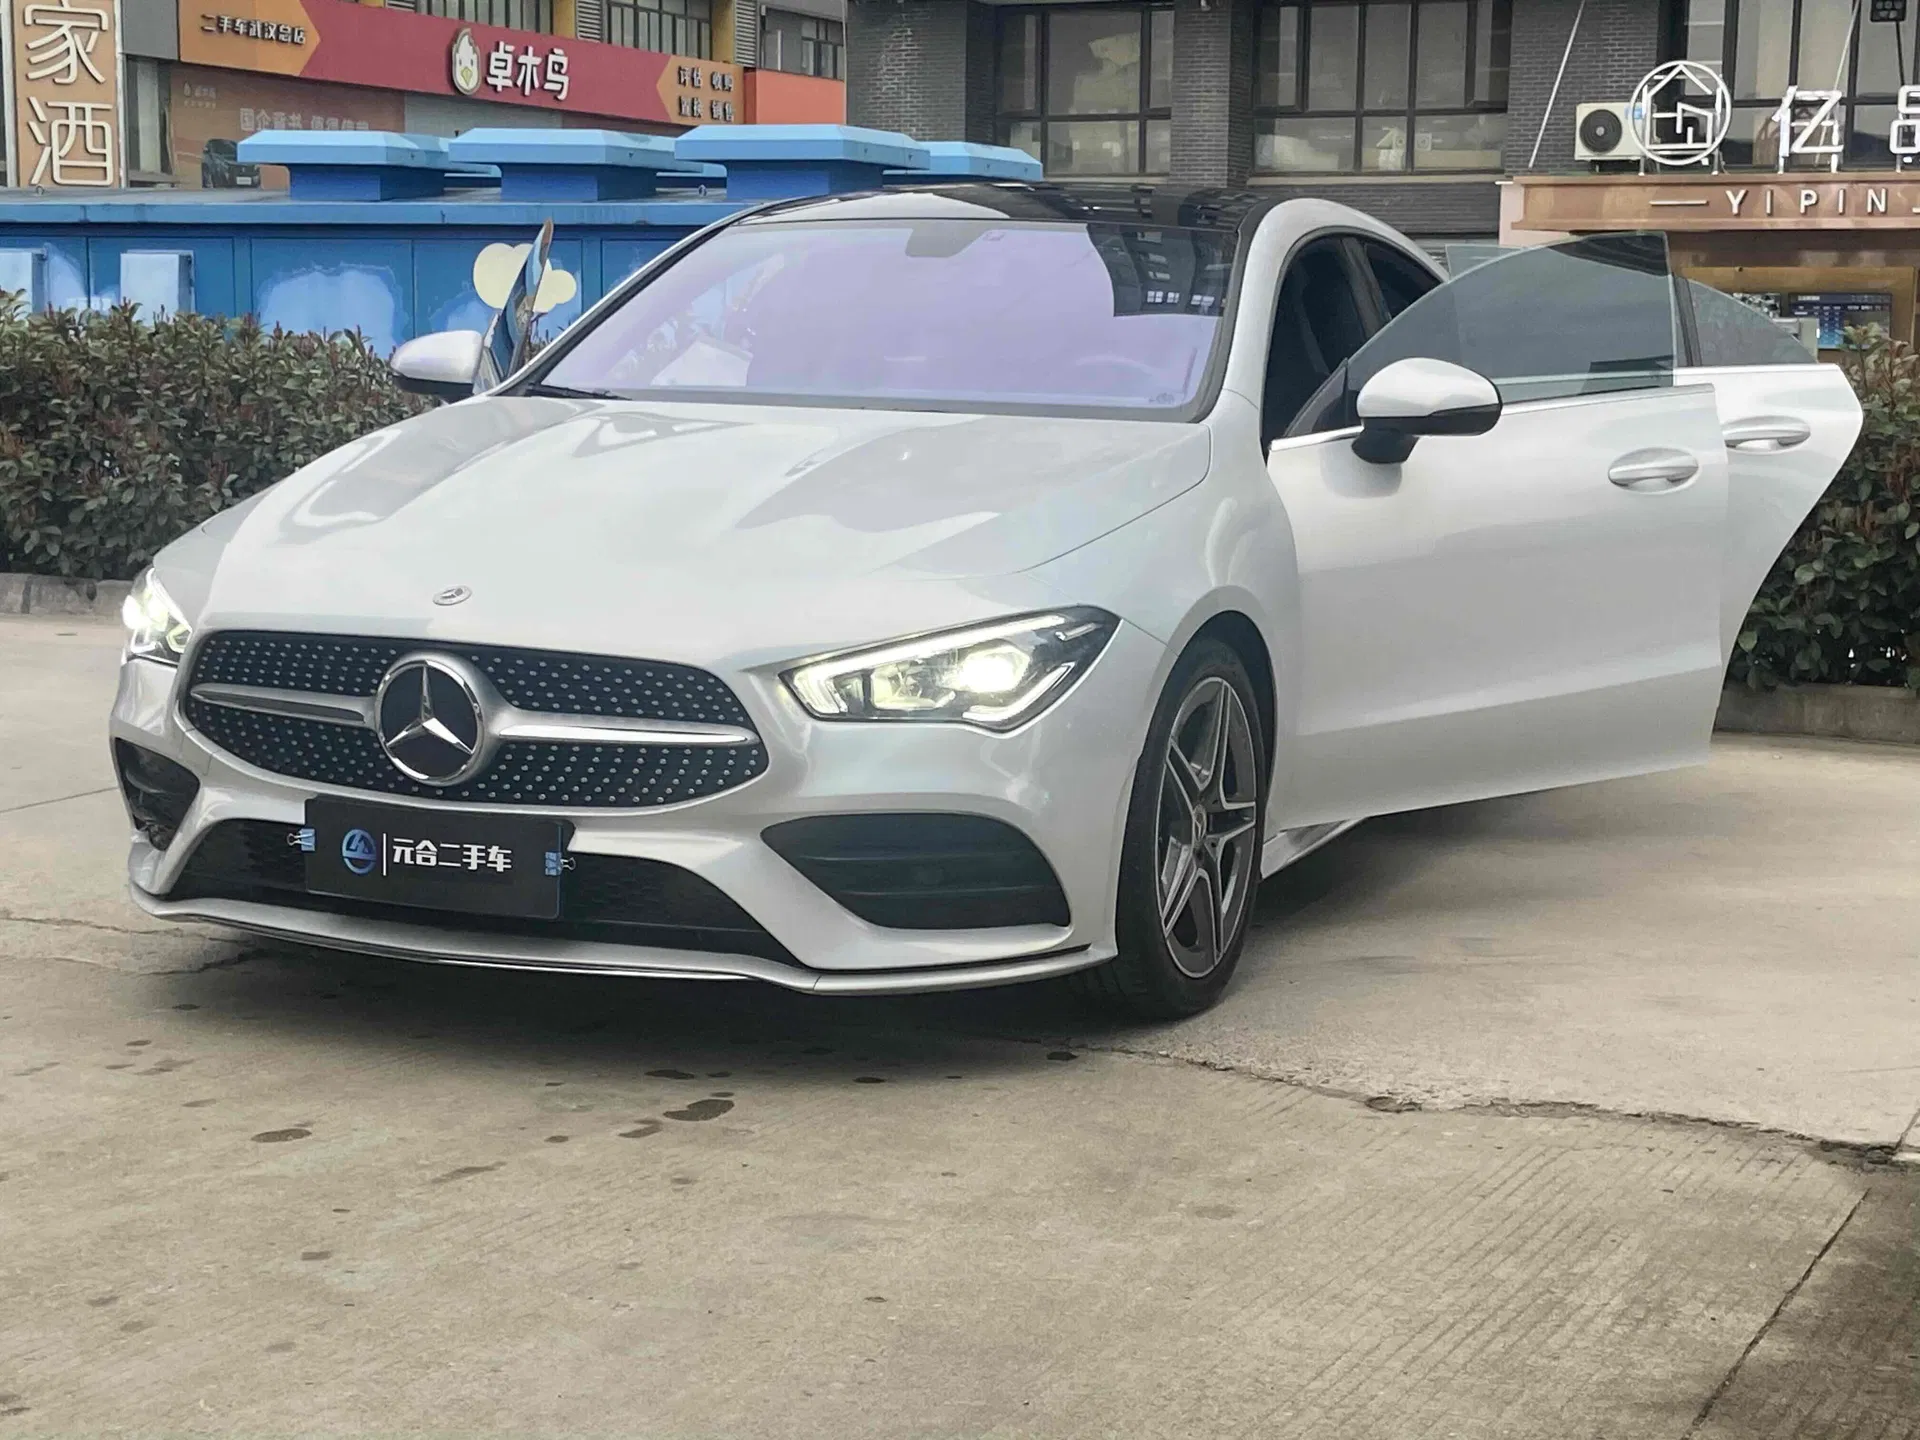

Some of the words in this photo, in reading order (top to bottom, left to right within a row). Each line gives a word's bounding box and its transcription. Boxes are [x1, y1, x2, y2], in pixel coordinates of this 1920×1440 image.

[201, 14, 306, 45] 二手车武汉总店
[486, 41, 570, 100] 卓木鸟
[678, 66, 703, 89] 评估
[393, 838, 512, 872] 元合二手车
